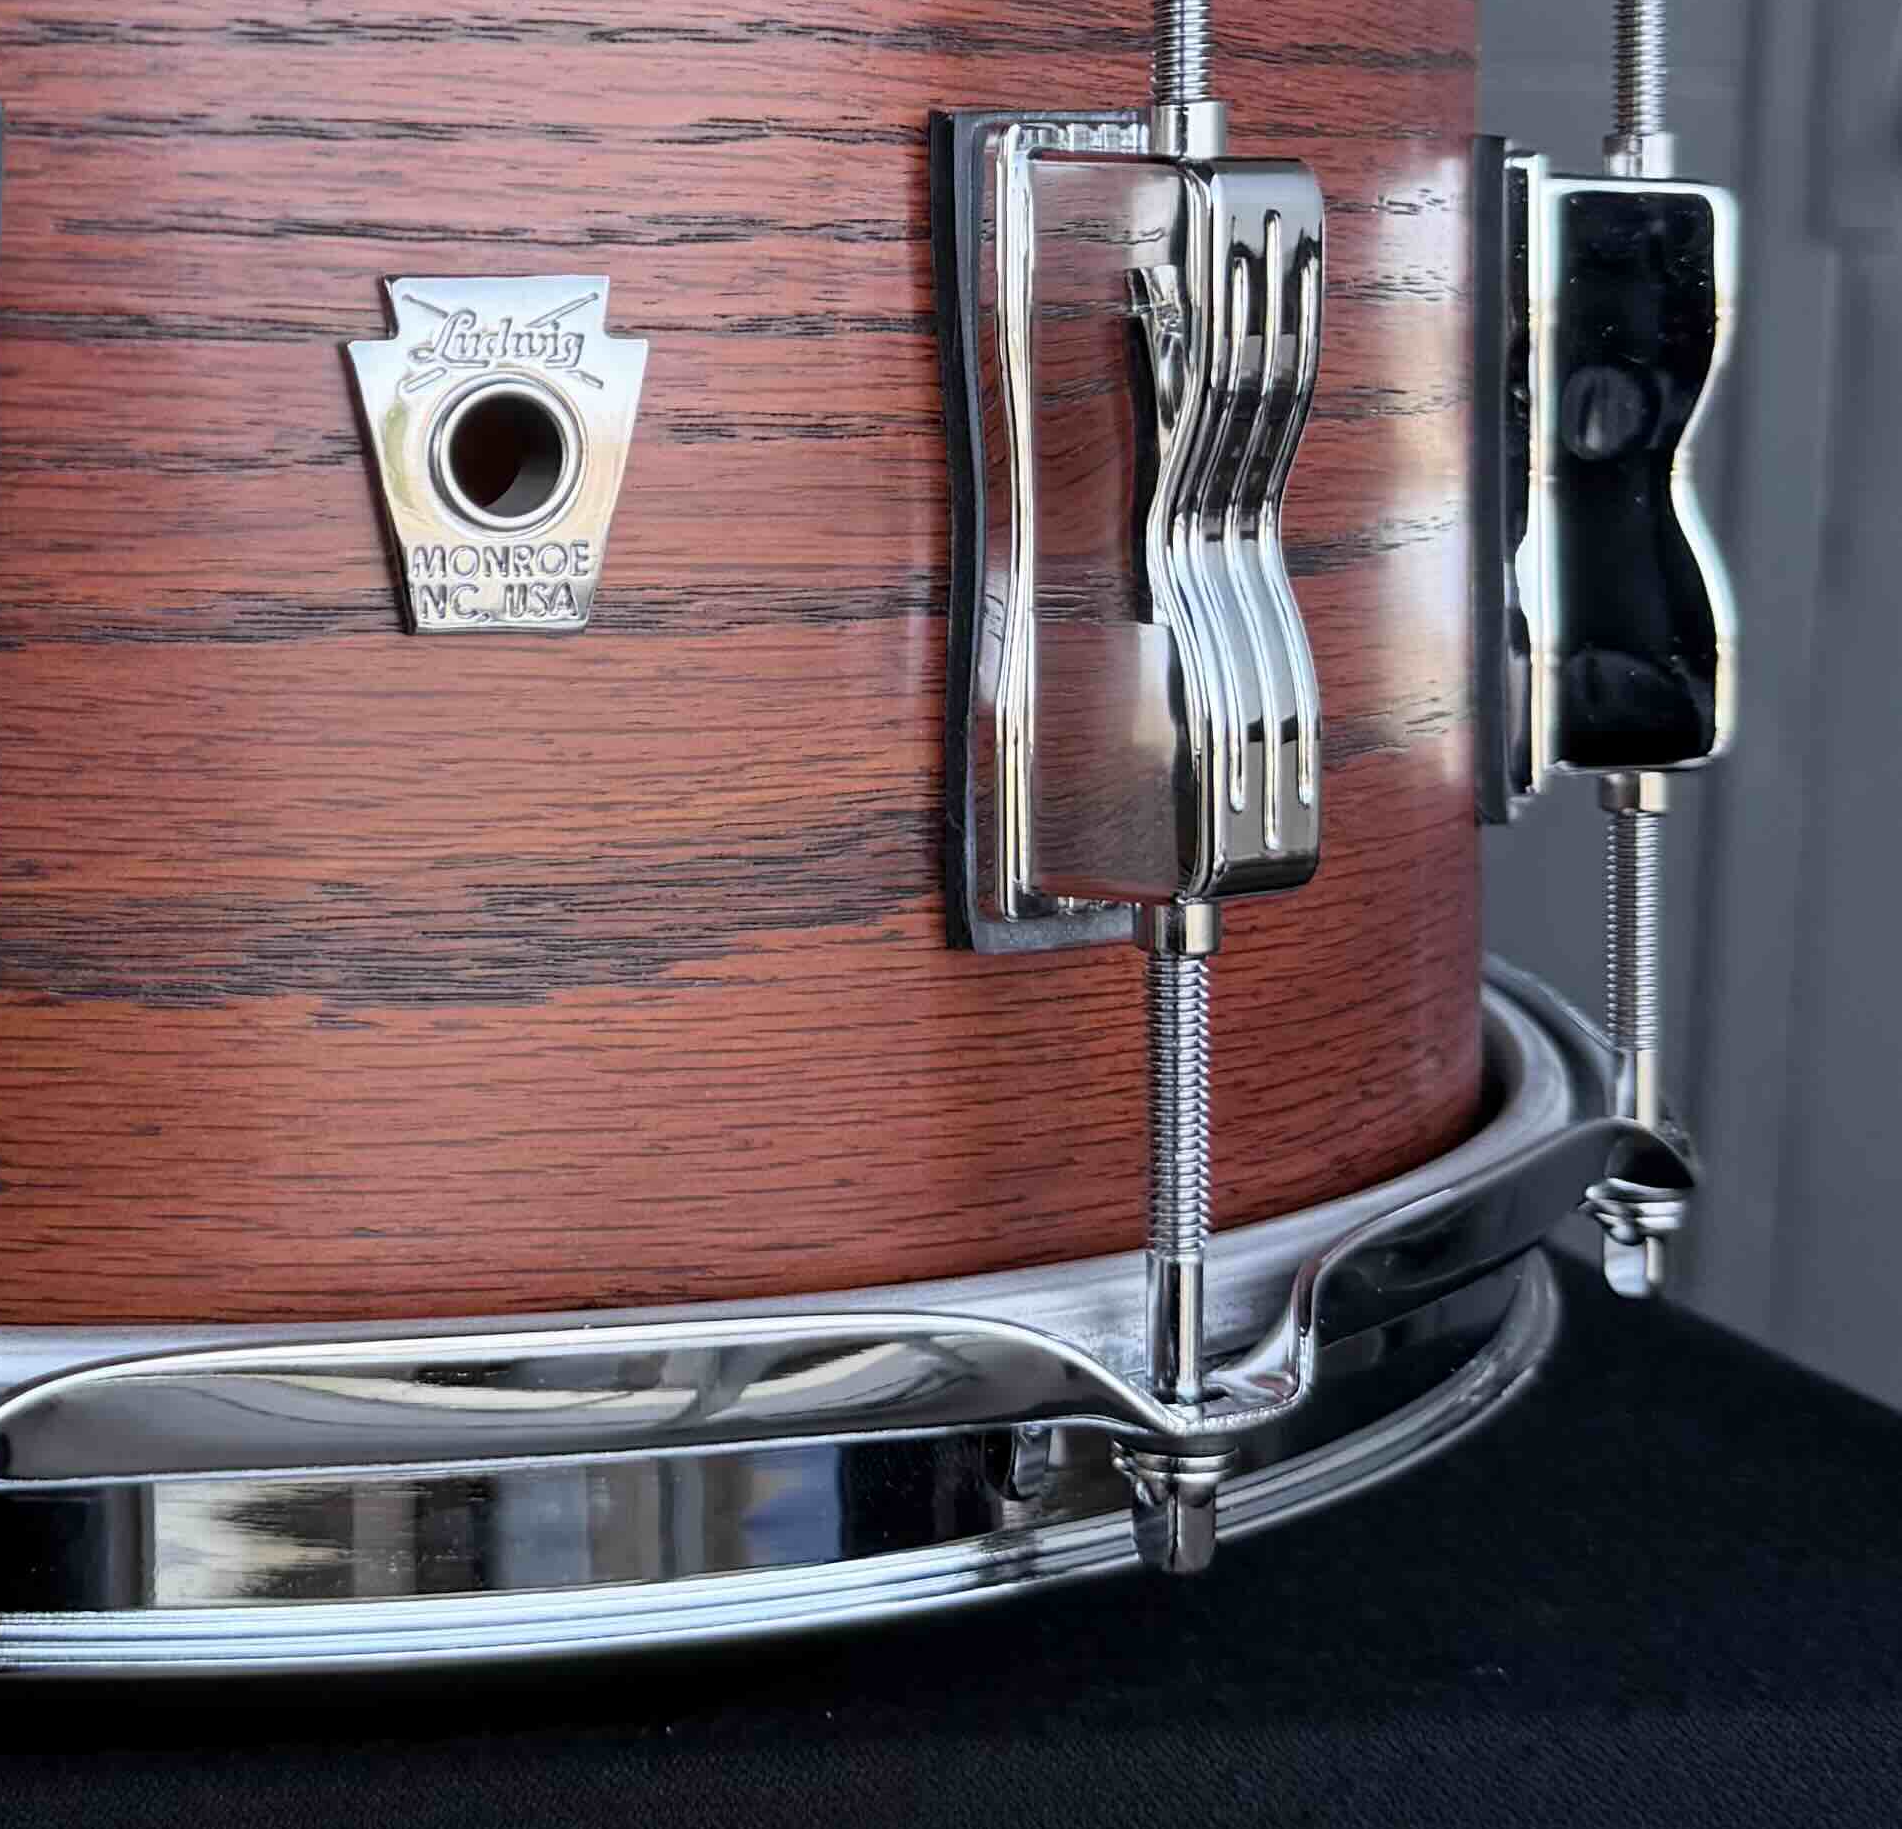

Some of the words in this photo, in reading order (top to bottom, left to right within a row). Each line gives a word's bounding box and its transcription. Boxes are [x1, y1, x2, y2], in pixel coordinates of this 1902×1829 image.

[409, 310, 584, 367] Ludwig
[412, 541, 590, 578] MONROE
[505, 580, 578, 618] USA
